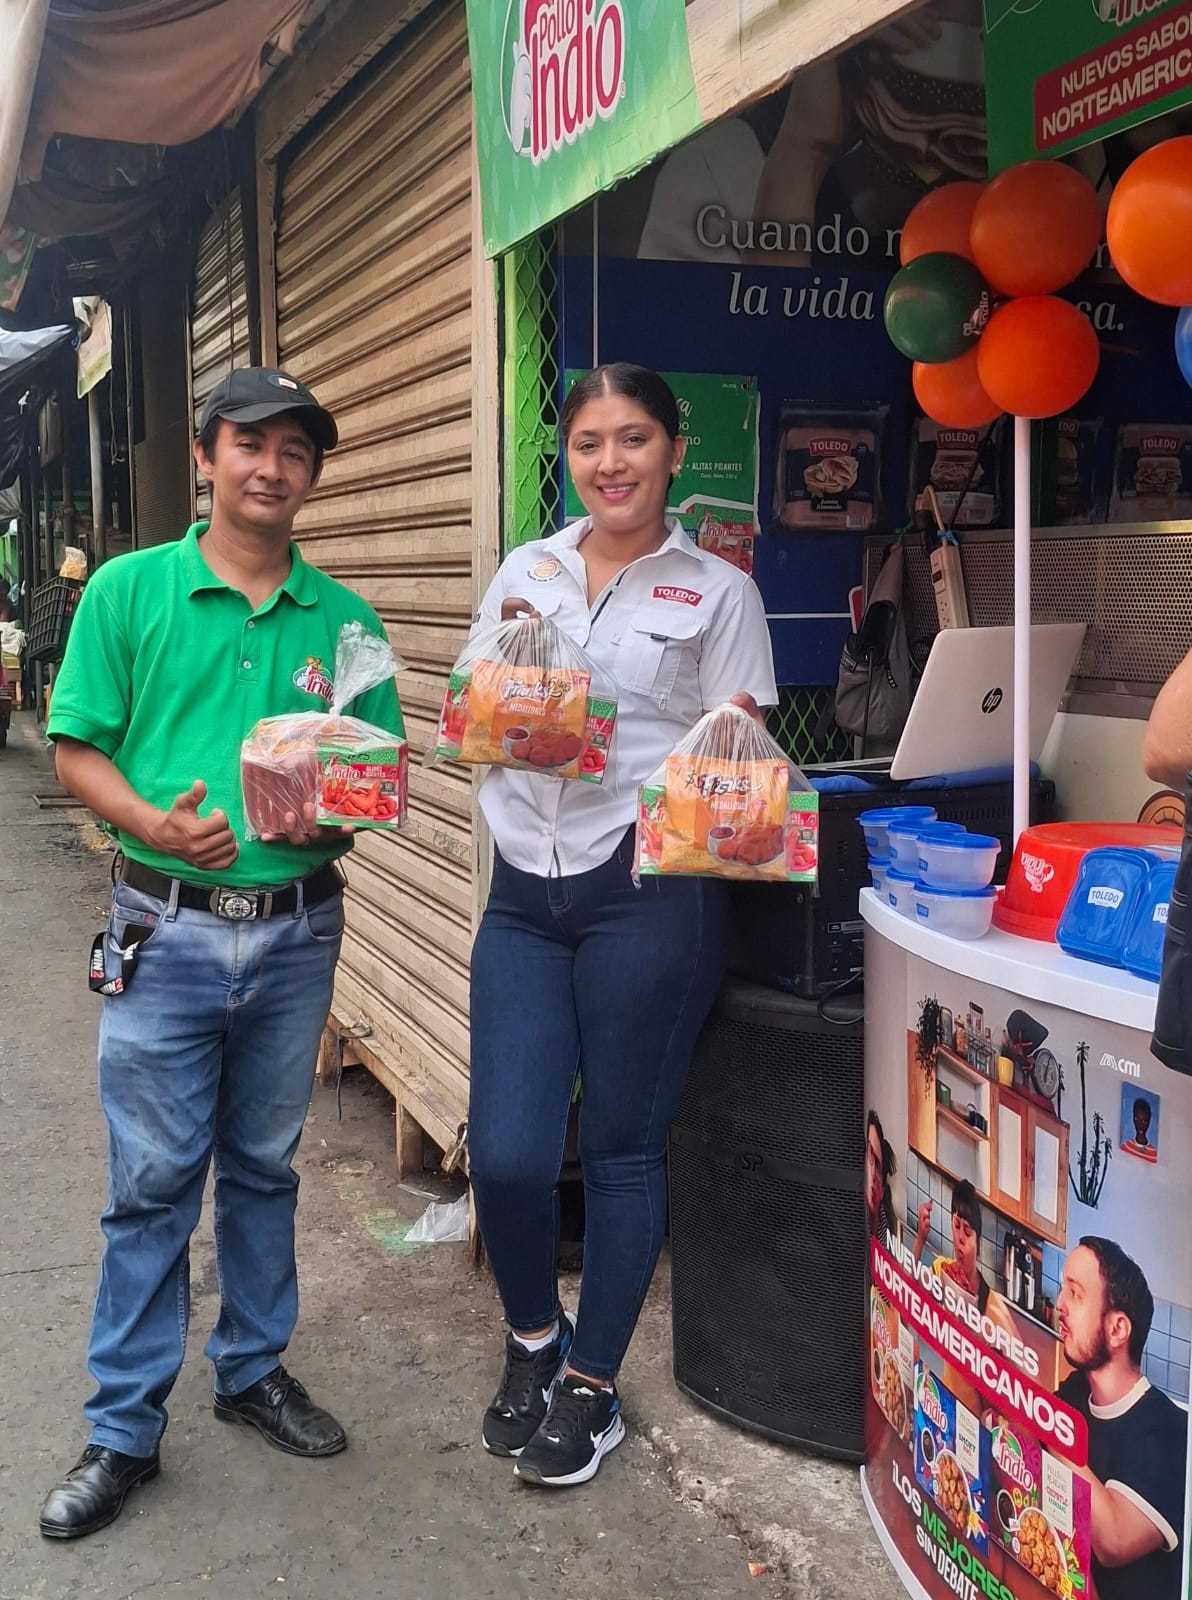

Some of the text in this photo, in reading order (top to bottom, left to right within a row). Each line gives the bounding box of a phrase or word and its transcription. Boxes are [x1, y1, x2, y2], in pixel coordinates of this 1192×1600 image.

[539, 0, 576, 58] Pollo
[530, 0, 622, 158] Indio
[1042, 47, 1192, 140] NORTEAMERIC
[1060, 44, 1133, 98] NUEVOS
[695, 204, 870, 256] Cuando
[728, 272, 769, 316] la
[782, 277, 875, 320] vida
[812, 440, 848, 452] TOLEDO
[940, 432, 975, 444] TOLEDO
[1142, 439, 1177, 449] TOLEDO
[656, 588, 697, 602] TOLEDO
[330, 763, 361, 780] Indio
[1091, 889, 1120, 903] TOLEDO
[886, 1228, 1040, 1377] NUEVOS SABORES
[873, 1247, 1076, 1447] NORTEAMERICANOS
[924, 1389, 948, 1432] Indio
[1000, 1445, 1033, 1492] Indio
[916, 1524, 979, 1600] SIN DEBATE
[923, 1502, 1016, 1600] MEJORES
